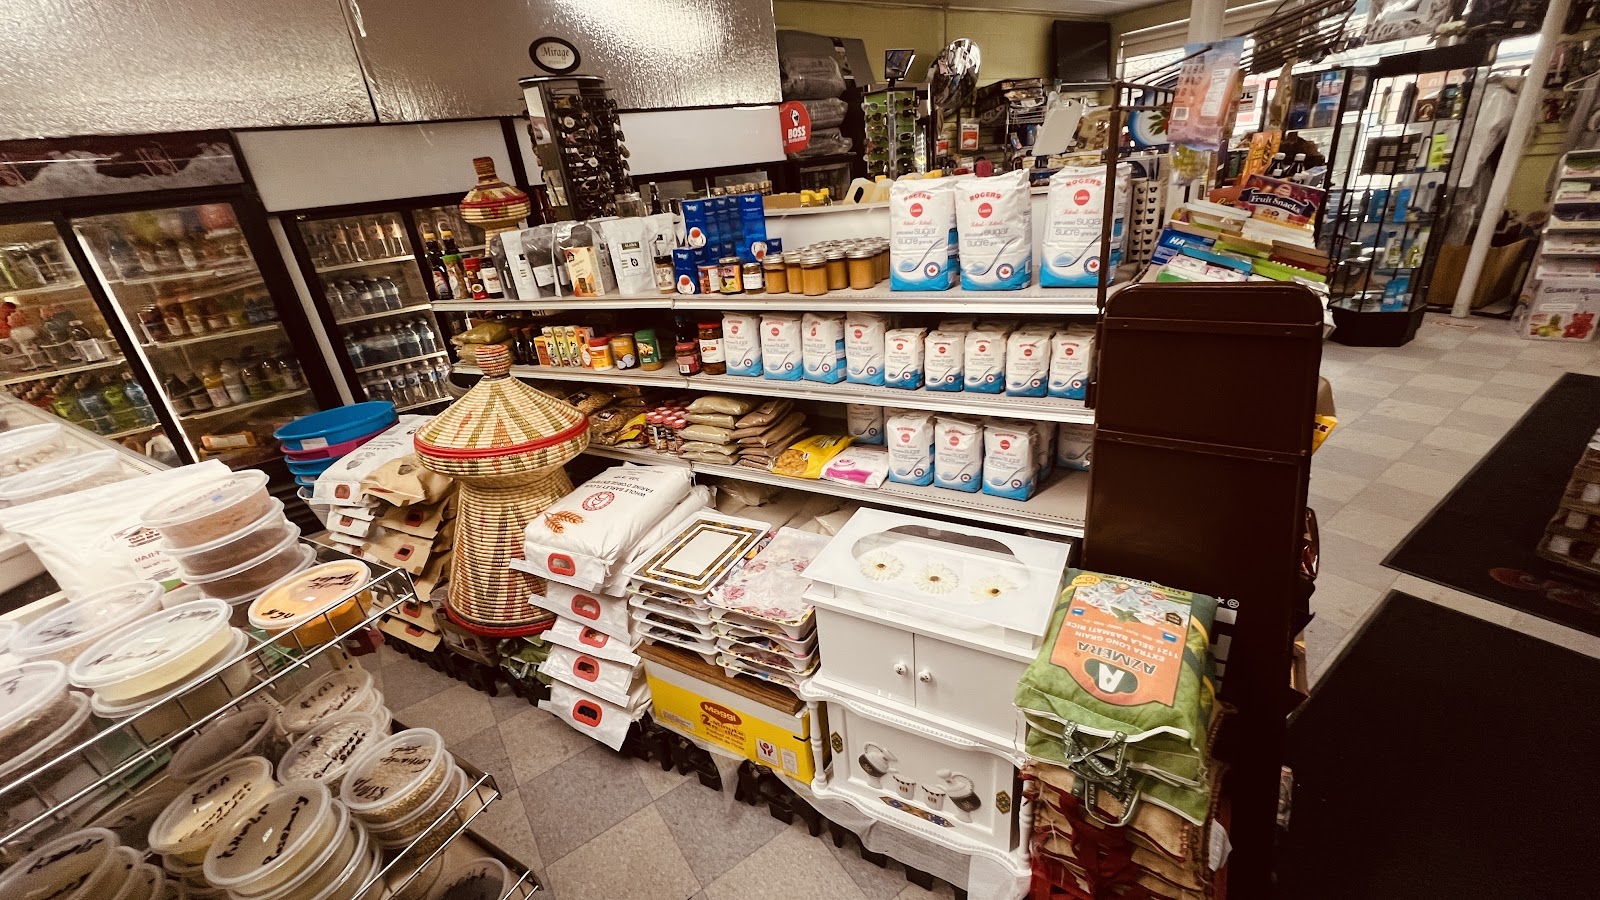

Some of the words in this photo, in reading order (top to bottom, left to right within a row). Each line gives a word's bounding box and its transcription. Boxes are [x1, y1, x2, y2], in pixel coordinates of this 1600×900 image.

[542, 46, 569, 60] Mirage
[787, 126, 806, 138] BOSS
[1066, 178, 1102, 187] ROGERS
[903, 192, 932, 201] ROGERS
[969, 191, 1003, 201] ROGERS
[1250, 195, 1272, 203] Fruit
[1272, 198, 1301, 214] Snacks
[914, 227, 936, 237] sugar
[984, 227, 1010, 238] sugar
[1055, 228, 1080, 237] sucre
[897, 238, 919, 246] sucre
[602, 484, 624, 492] BARLEY
[623, 487, 646, 498] WHOLE
[632, 483, 654, 493] FARINE
[1065, 620, 1087, 631] RICE
[1074, 630, 1104, 642] GRAIN
[1088, 626, 1128, 641] BASMATI
[1106, 637, 1131, 653] LONG
[1130, 637, 1155, 651] SELA
[1078, 642, 1157, 674] AZMERA
[1133, 646, 1166, 663] EXTRA
[1156, 646, 1179, 659] 1121
[704, 704, 737, 722] Maggi
[262, 796, 309, 865] Rosemary
